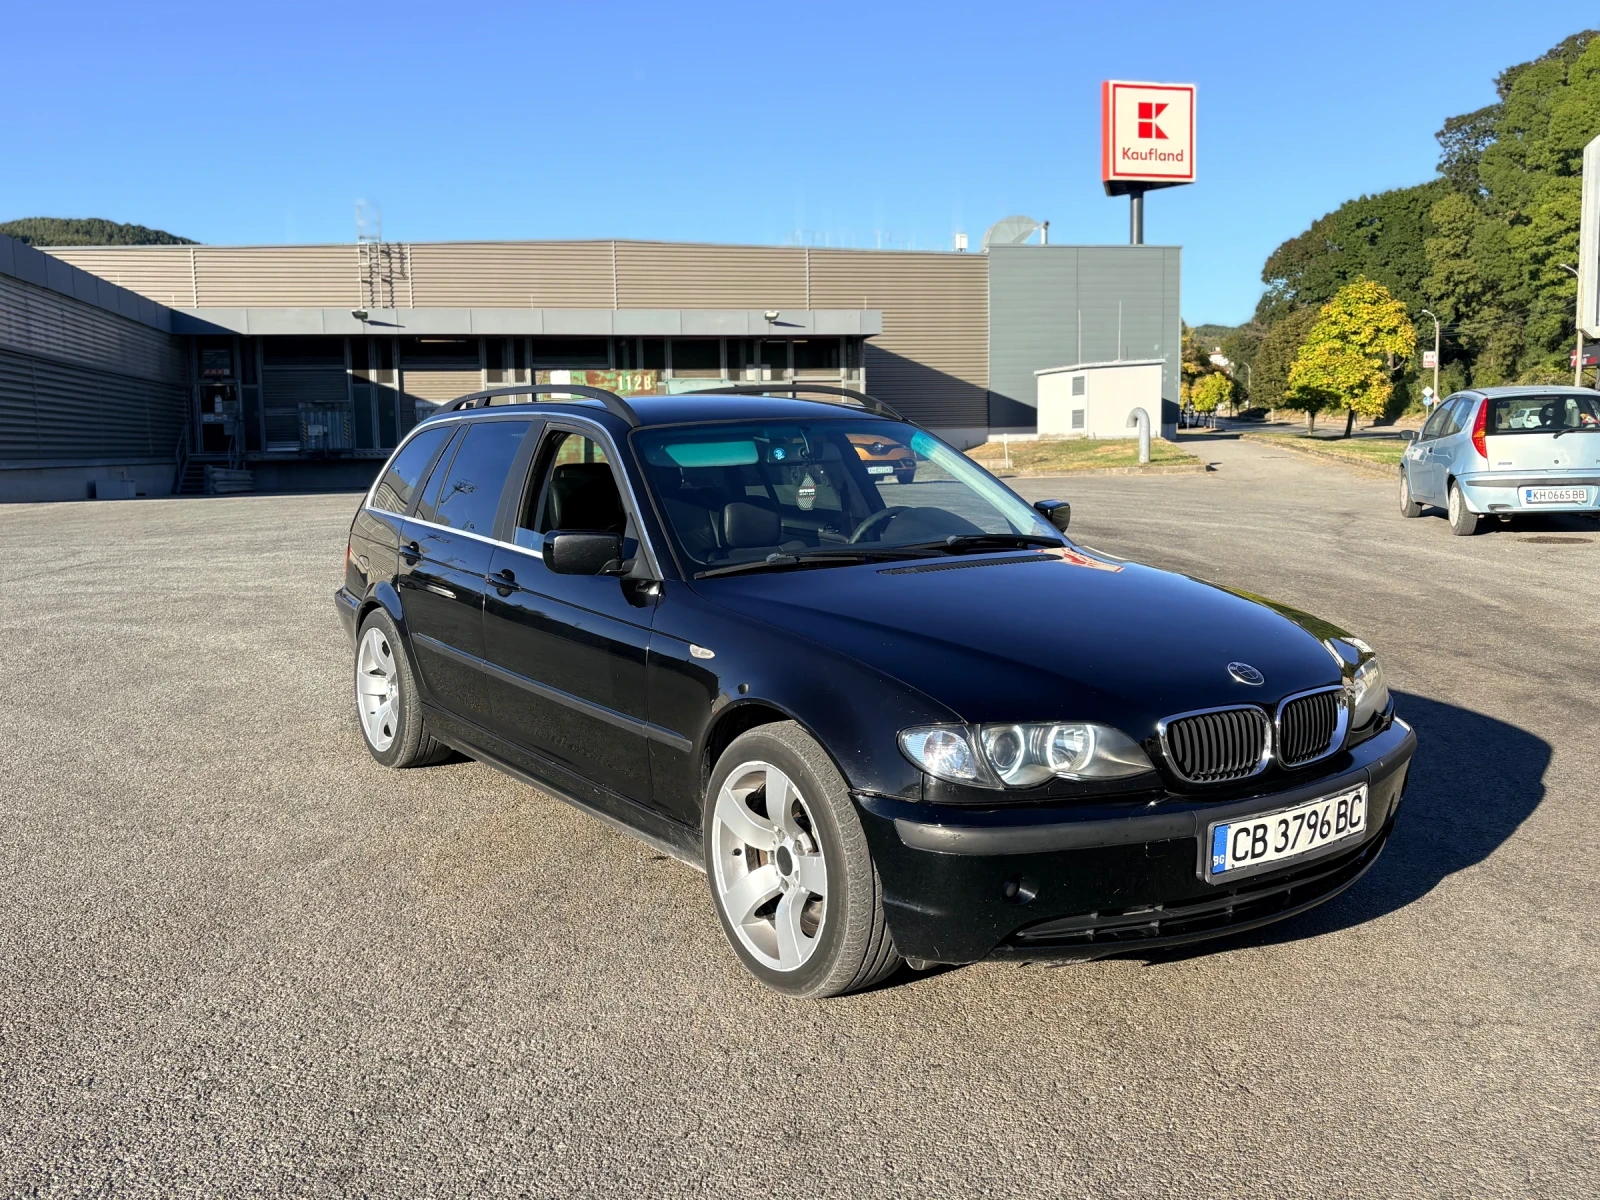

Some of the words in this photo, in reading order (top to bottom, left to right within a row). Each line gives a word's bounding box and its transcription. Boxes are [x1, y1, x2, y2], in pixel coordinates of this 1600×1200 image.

[1122, 147, 1184, 162] Kaufland
[617, 375, 652, 391] 112B
[1533, 491, 1546, 500] KH
[1547, 490, 1571, 500] 0665
[1572, 490, 1585, 499] BB
[1231, 823, 1268, 862] CB
[1274, 805, 1332, 854] 3796
[1335, 794, 1363, 835] BC
[1212, 855, 1226, 866] BG
